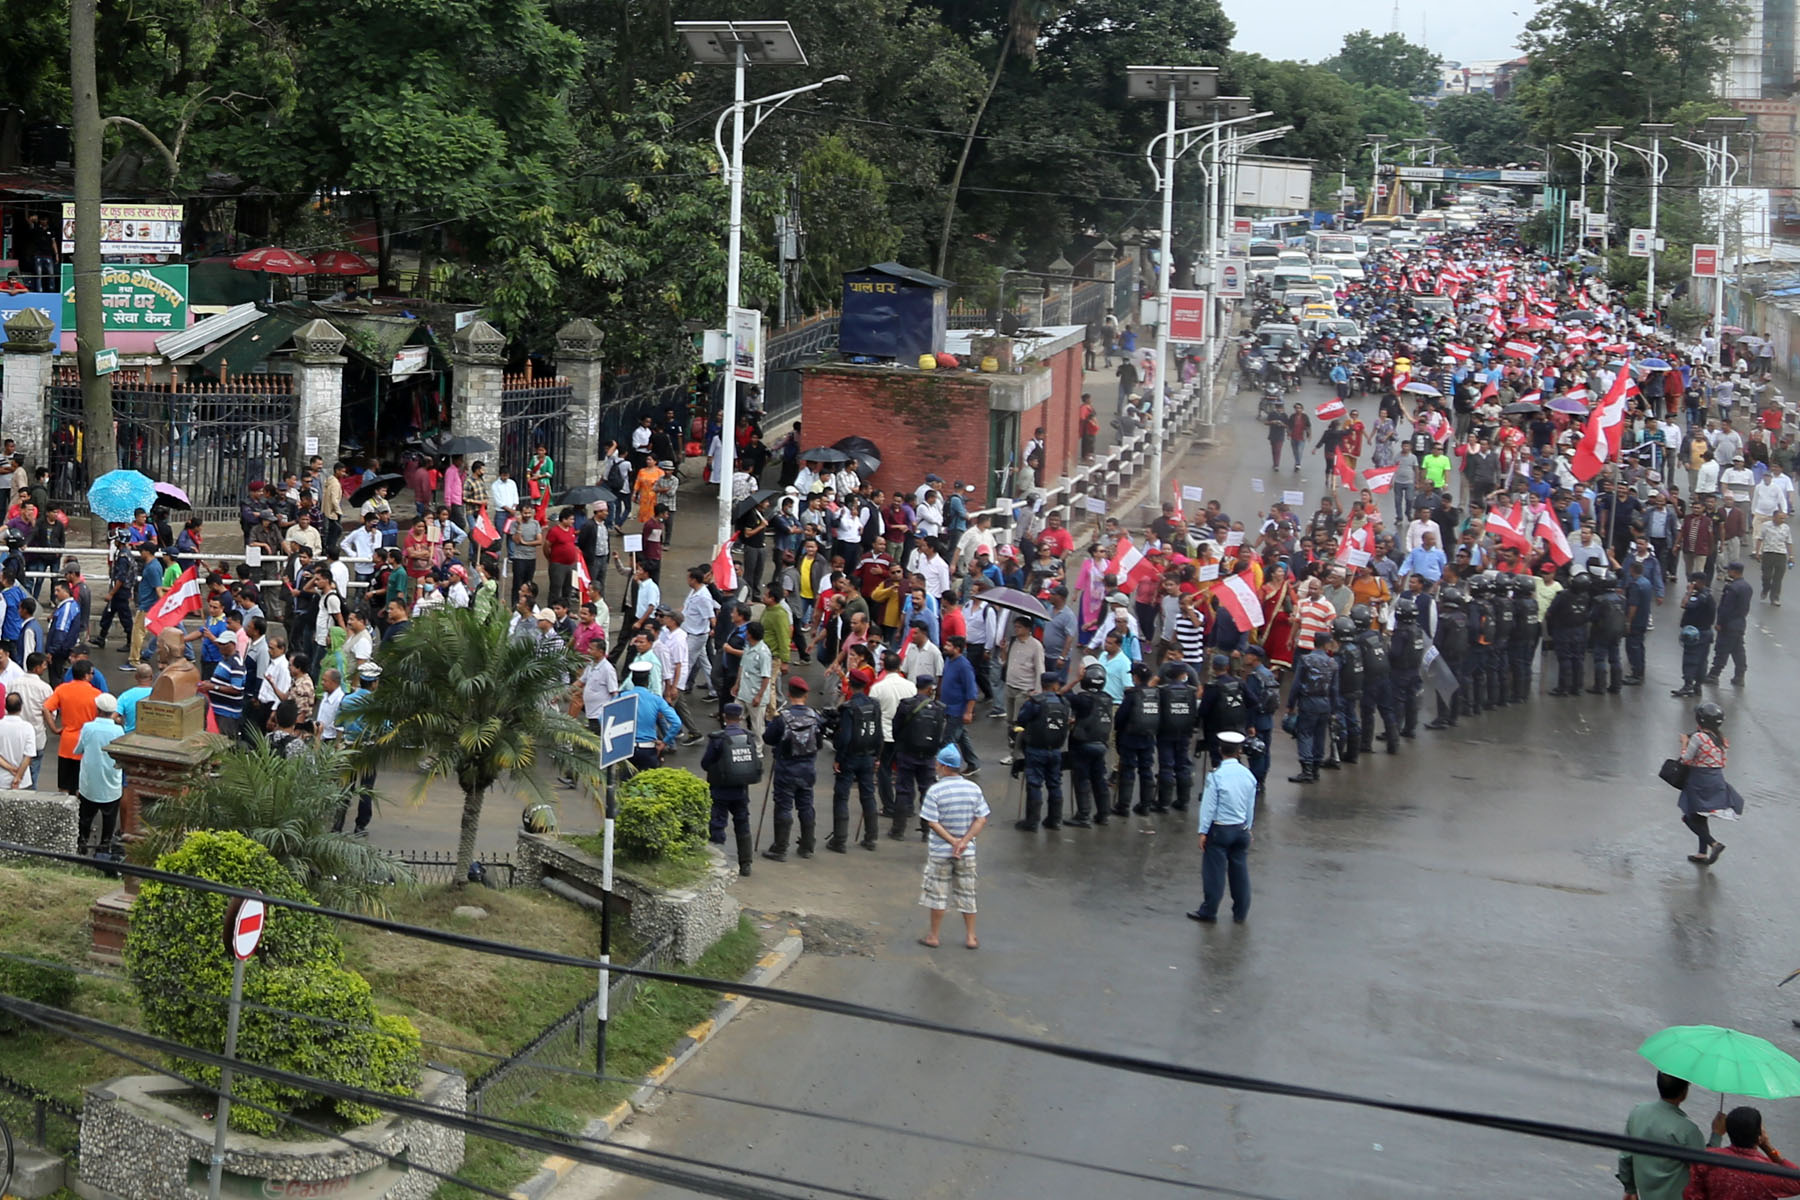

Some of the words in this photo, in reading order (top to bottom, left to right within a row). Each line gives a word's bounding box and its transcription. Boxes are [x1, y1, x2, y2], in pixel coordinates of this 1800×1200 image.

[133, 294, 156, 310] घर
[112, 310, 139, 324] सेवा
[731, 748, 752, 756] NEPAL
[732, 754, 753, 763] POLICE
